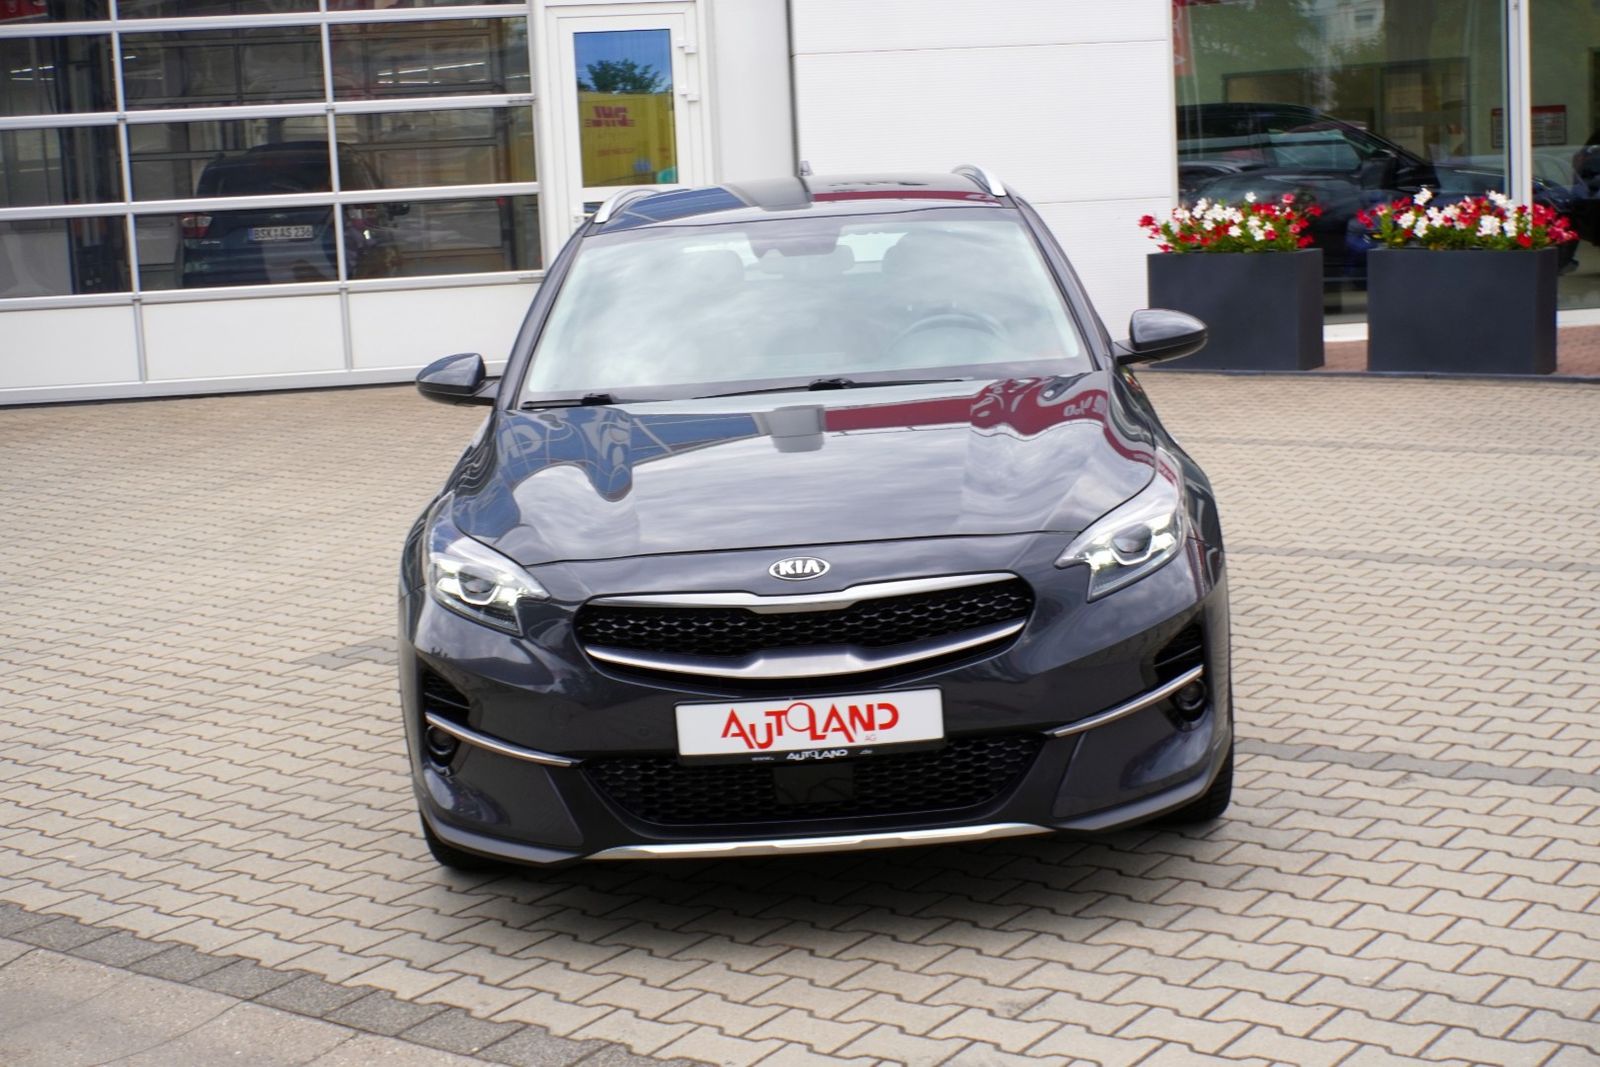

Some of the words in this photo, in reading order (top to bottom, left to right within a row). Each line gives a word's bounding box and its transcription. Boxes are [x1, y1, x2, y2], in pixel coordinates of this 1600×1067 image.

[779, 559, 820, 575] KIA
[721, 702, 899, 749] AUTOLAND
[786, 749, 848, 761] AUTOLAND
